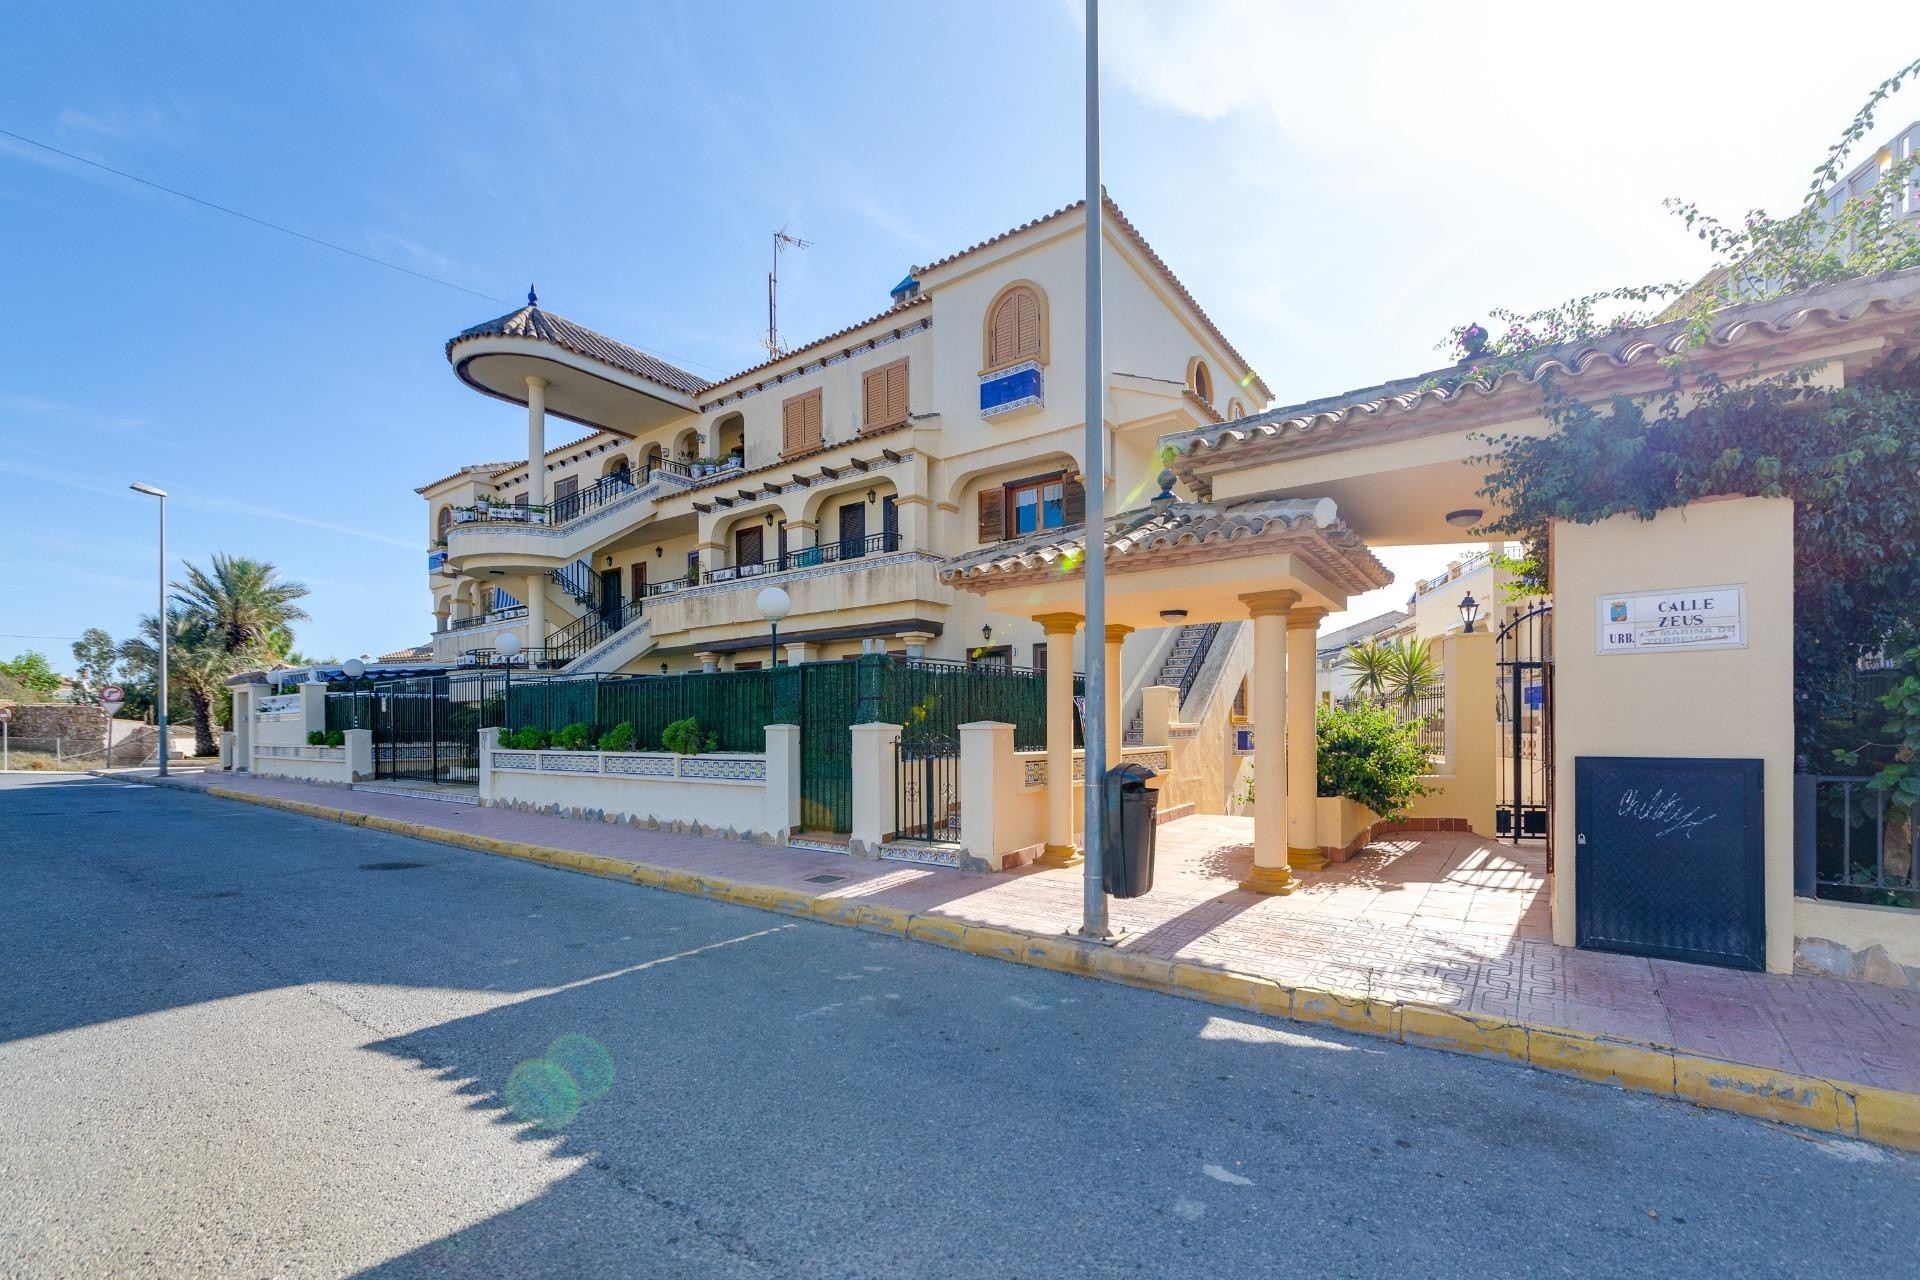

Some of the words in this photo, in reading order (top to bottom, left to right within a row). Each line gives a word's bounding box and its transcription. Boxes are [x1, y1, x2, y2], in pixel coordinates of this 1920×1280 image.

[1658, 598, 1714, 612] CALLE
[1658, 614, 1703, 627] ZEUS
[1659, 626, 1714, 637] MARINA
[1718, 624, 1736, 633] DE
[1609, 633, 1635, 644] URB.
[1646, 634, 1728, 644] TORREVIE
